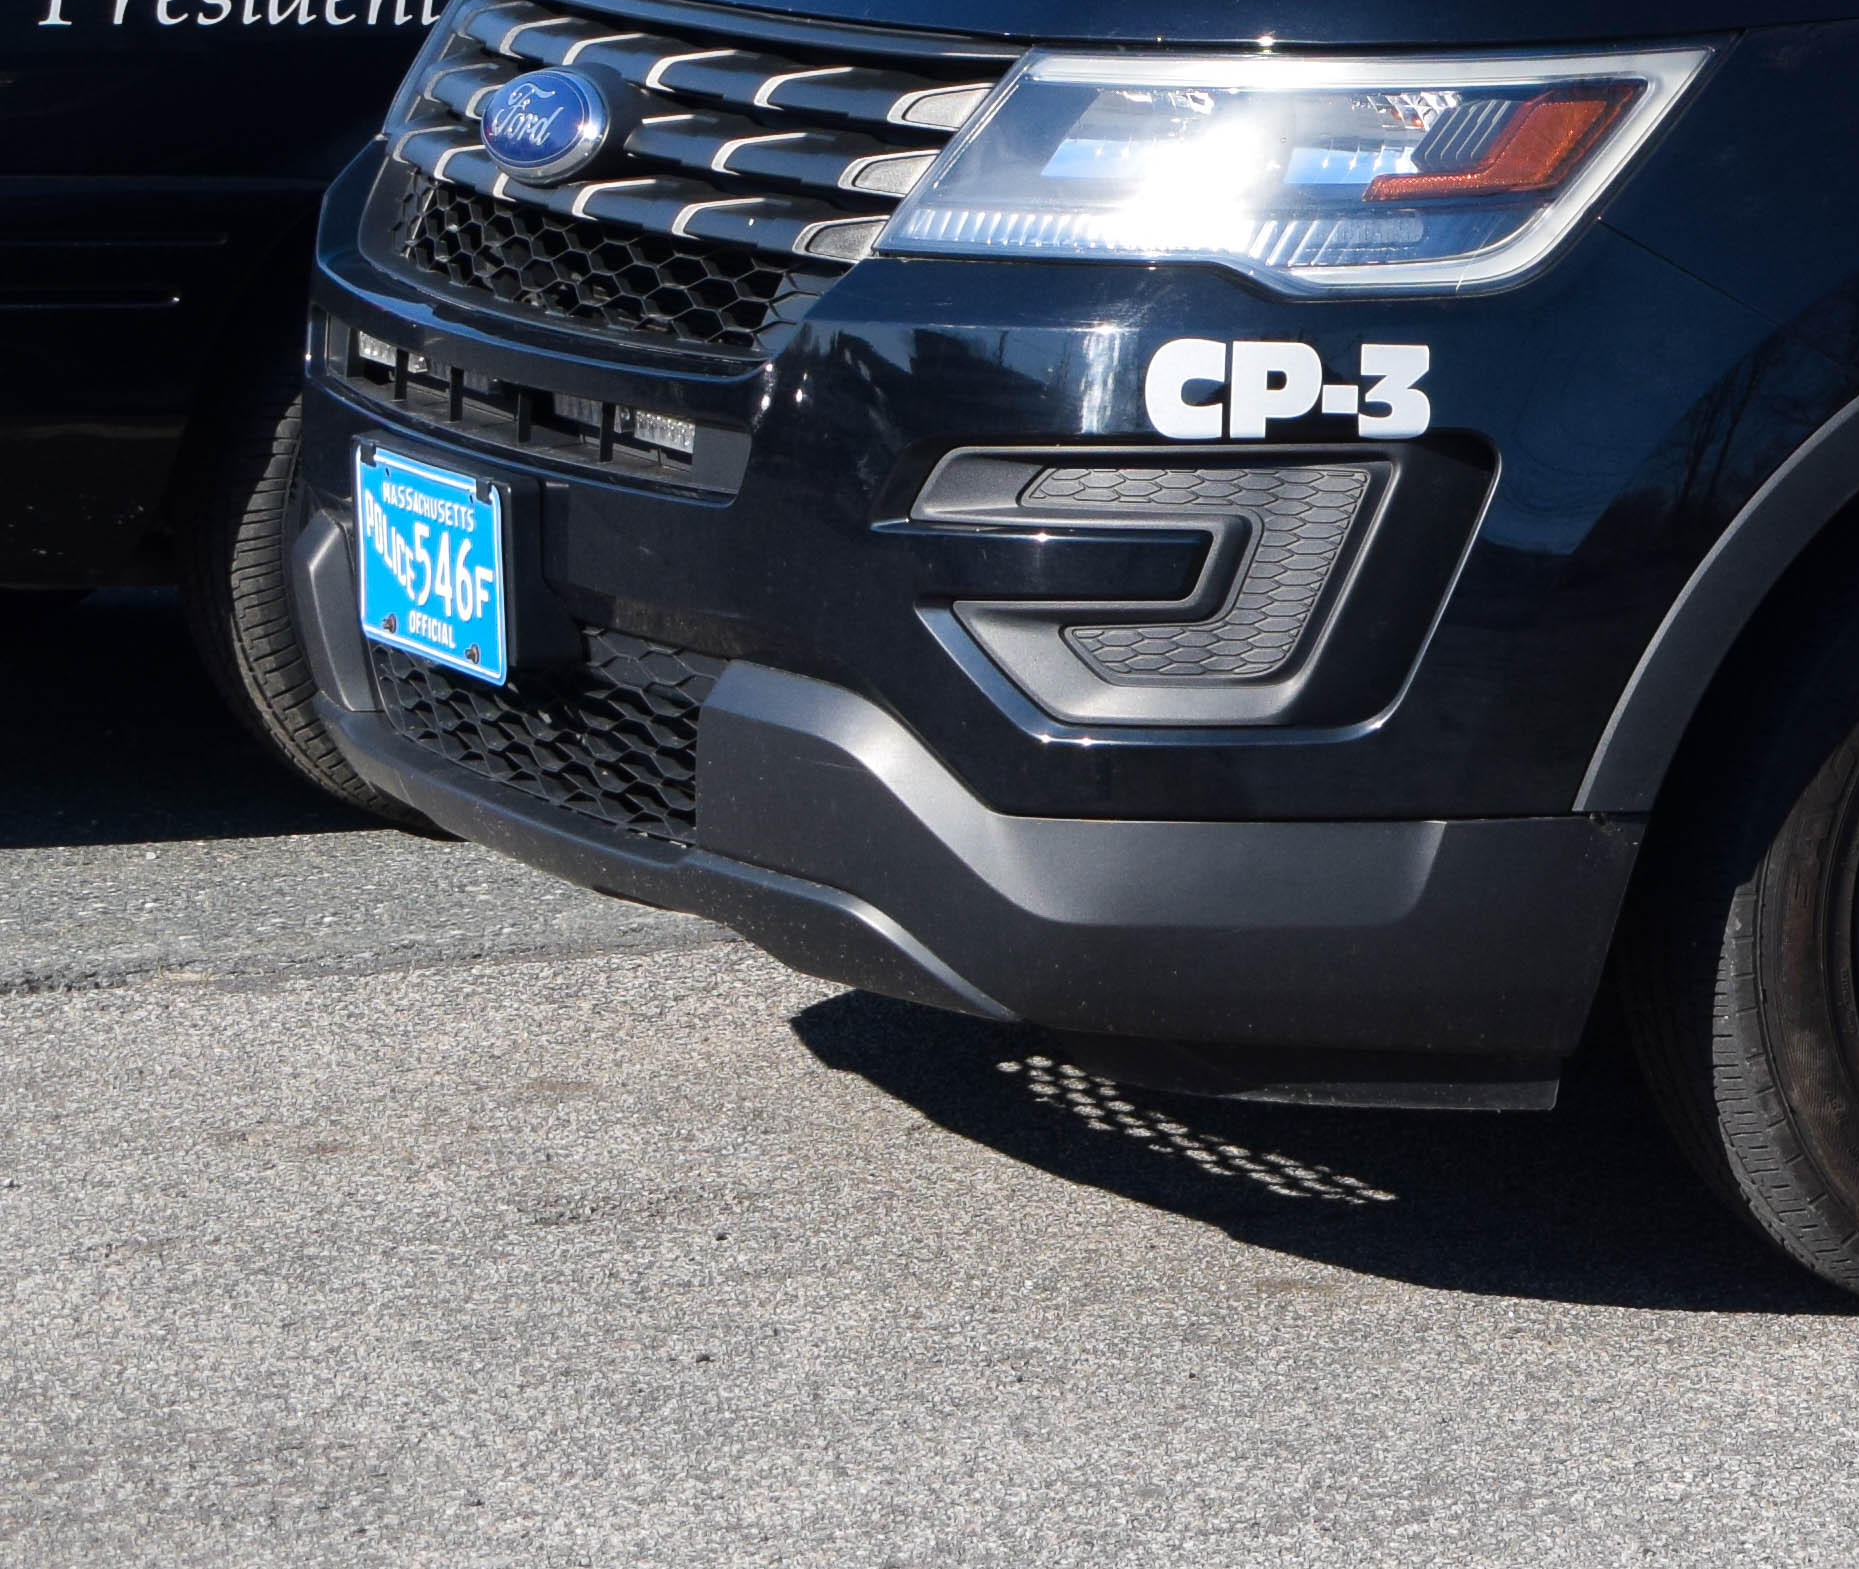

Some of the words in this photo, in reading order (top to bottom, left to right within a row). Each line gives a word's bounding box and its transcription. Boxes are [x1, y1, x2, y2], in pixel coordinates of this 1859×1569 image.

[490, 82, 565, 146] Ford
[1144, 338, 1431, 440] CP-3
[382, 481, 474, 533] MASSACHUSETTS
[364, 488, 416, 601] POLICE
[413, 521, 493, 622] 546F
[409, 609, 456, 649] OFFICIAL
